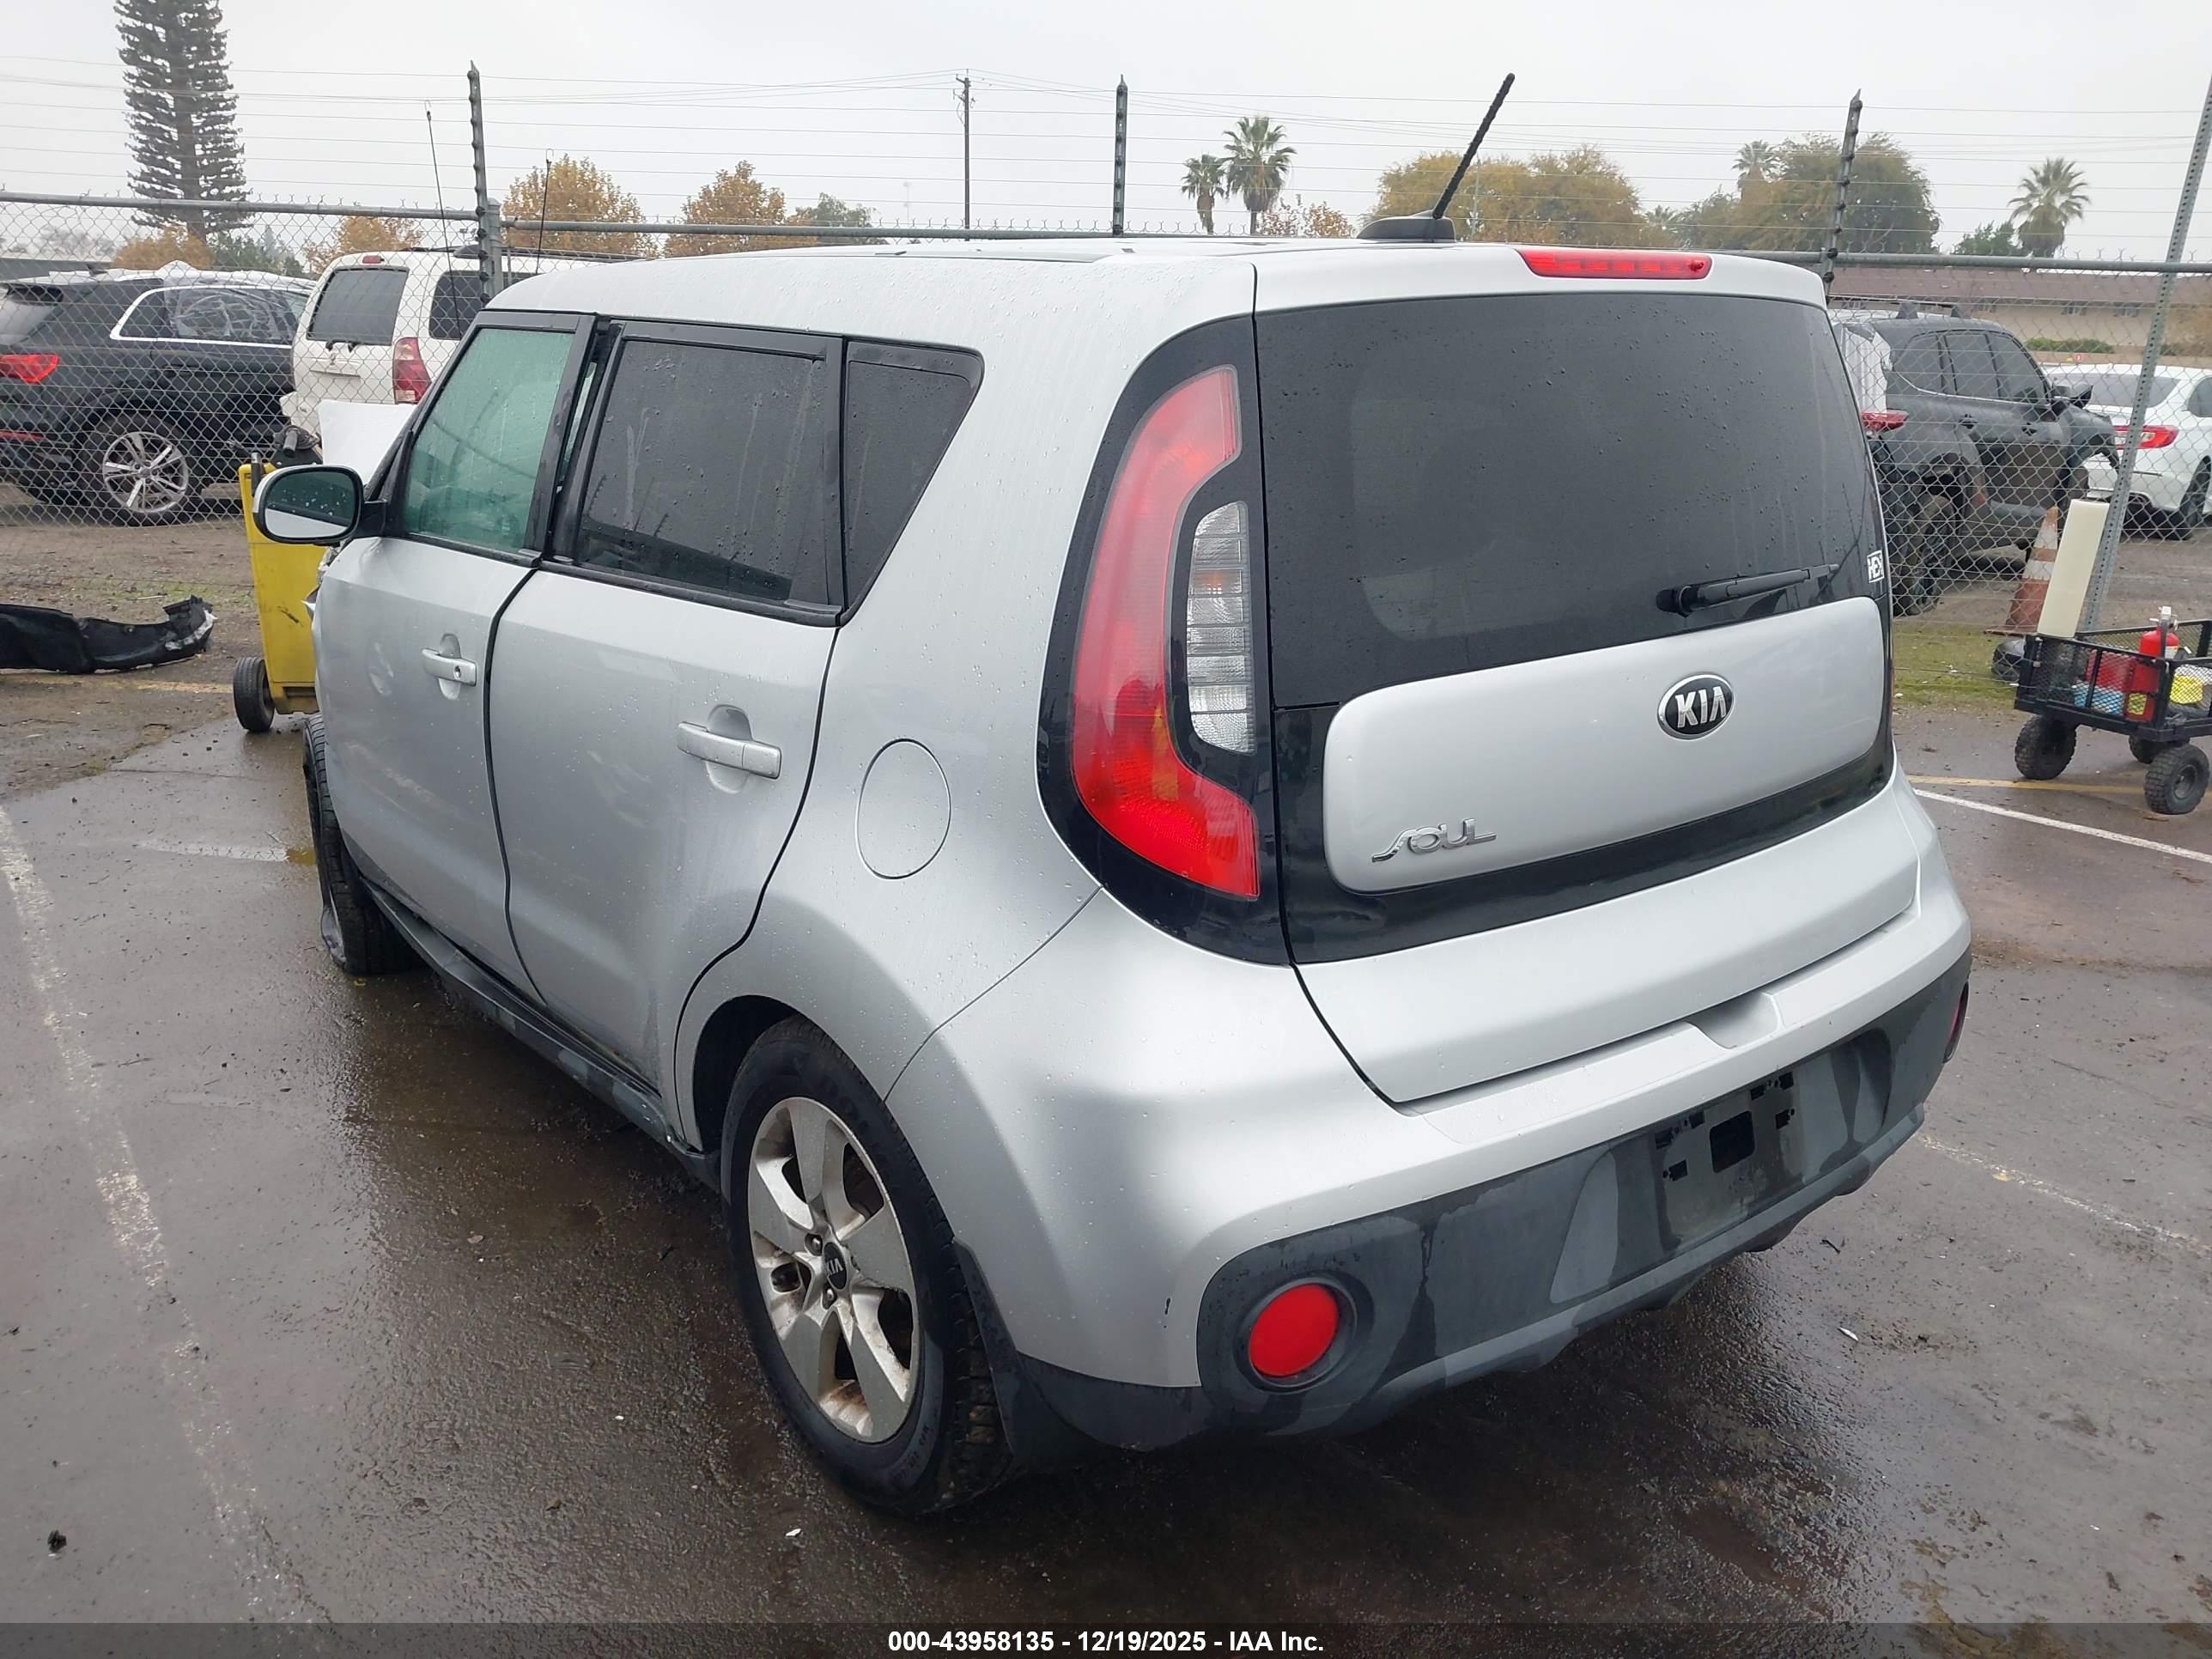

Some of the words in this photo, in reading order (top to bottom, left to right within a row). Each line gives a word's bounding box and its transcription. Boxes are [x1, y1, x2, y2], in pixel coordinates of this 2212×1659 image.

[1674, 685, 1727, 728] KIA
[1371, 817, 1498, 863] SOUL
[825, 1257, 845, 1277] KIA
